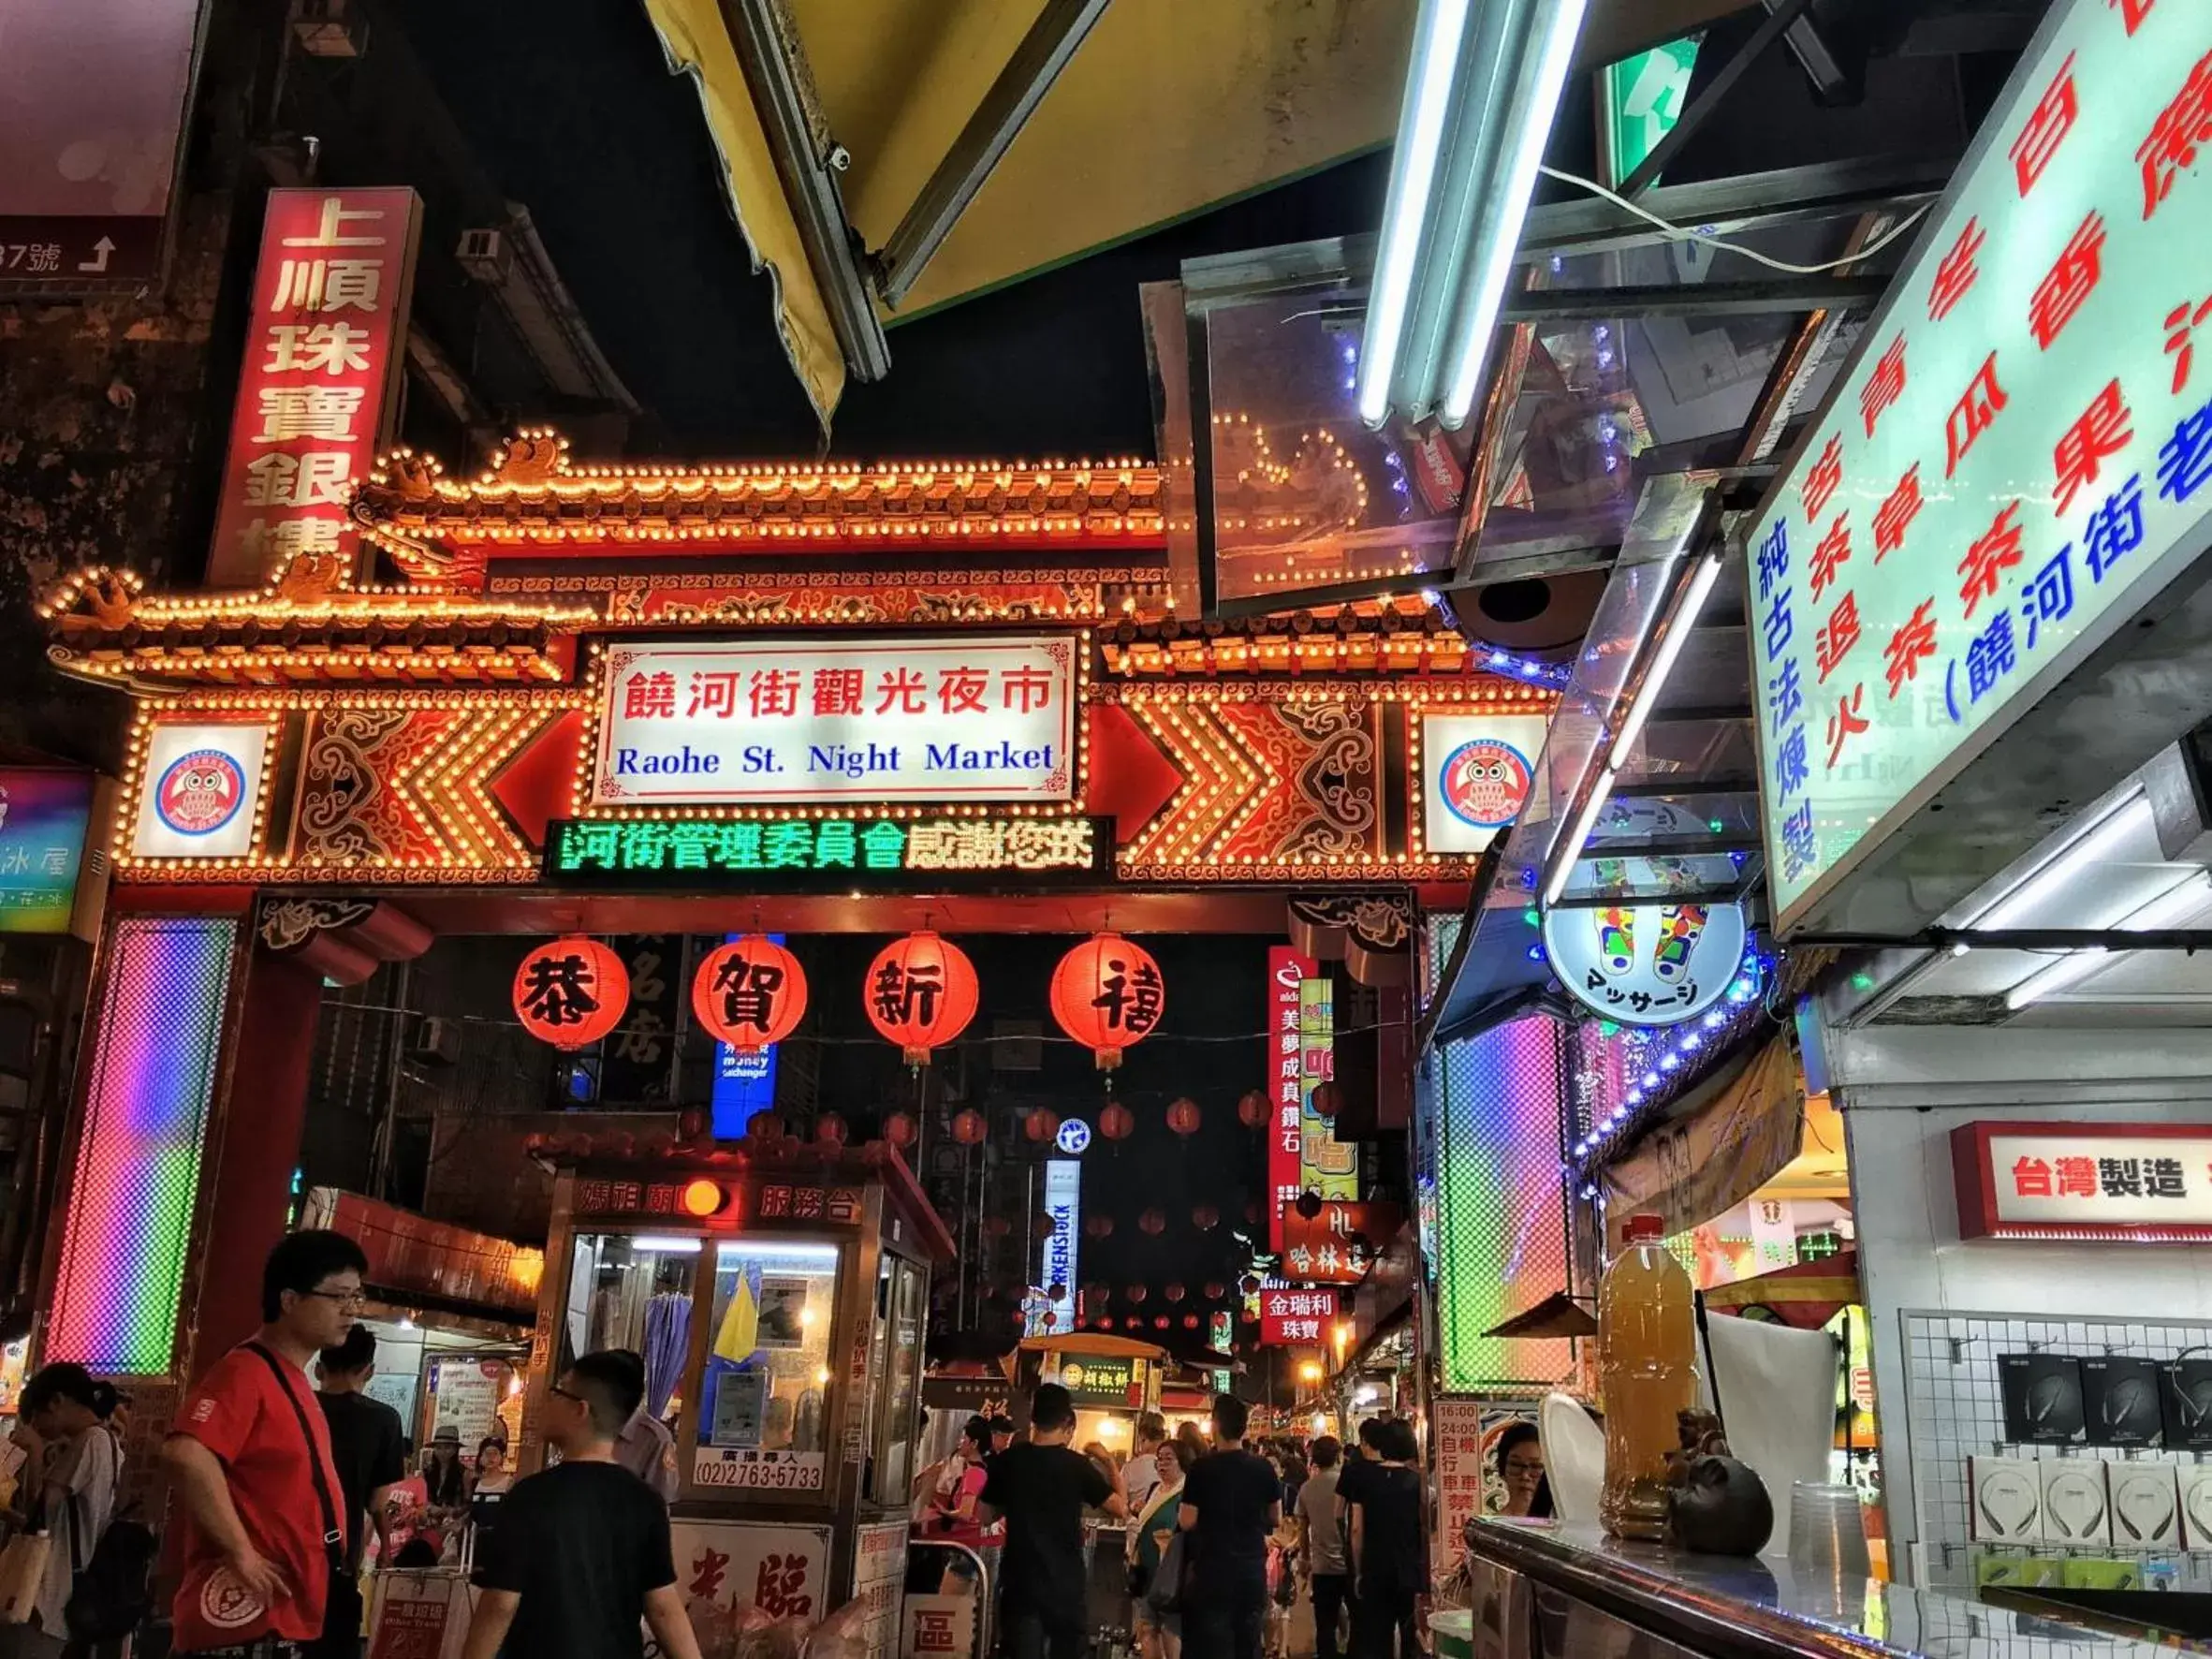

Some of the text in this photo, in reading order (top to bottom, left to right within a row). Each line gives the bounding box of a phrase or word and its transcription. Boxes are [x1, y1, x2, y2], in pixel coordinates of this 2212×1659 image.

[624, 664, 1053, 720] 饒河街觀光夜市
[617, 741, 1054, 779] Raohe St. Night Market
[520, 953, 1164, 1034] 恭 賀 新 禧
[1587, 968, 1698, 1013] マッサージ
[1281, 1009, 1299, 1152] 美夢成真鑽石
[2012, 1155, 2188, 1198] 台灣製造
[580, 1182, 688, 1213] 媽祖廟
[1051, 1204, 1071, 1286] RKENSTOCK
[1268, 1294, 1332, 1317] 金瑞利
[1282, 1320, 1320, 1340] 珠寶
[1440, 1406, 1475, 1417] 16:00
[1441, 1422, 1477, 1434] 24:00
[696, 1462, 820, 1488] (02)2763-5733
